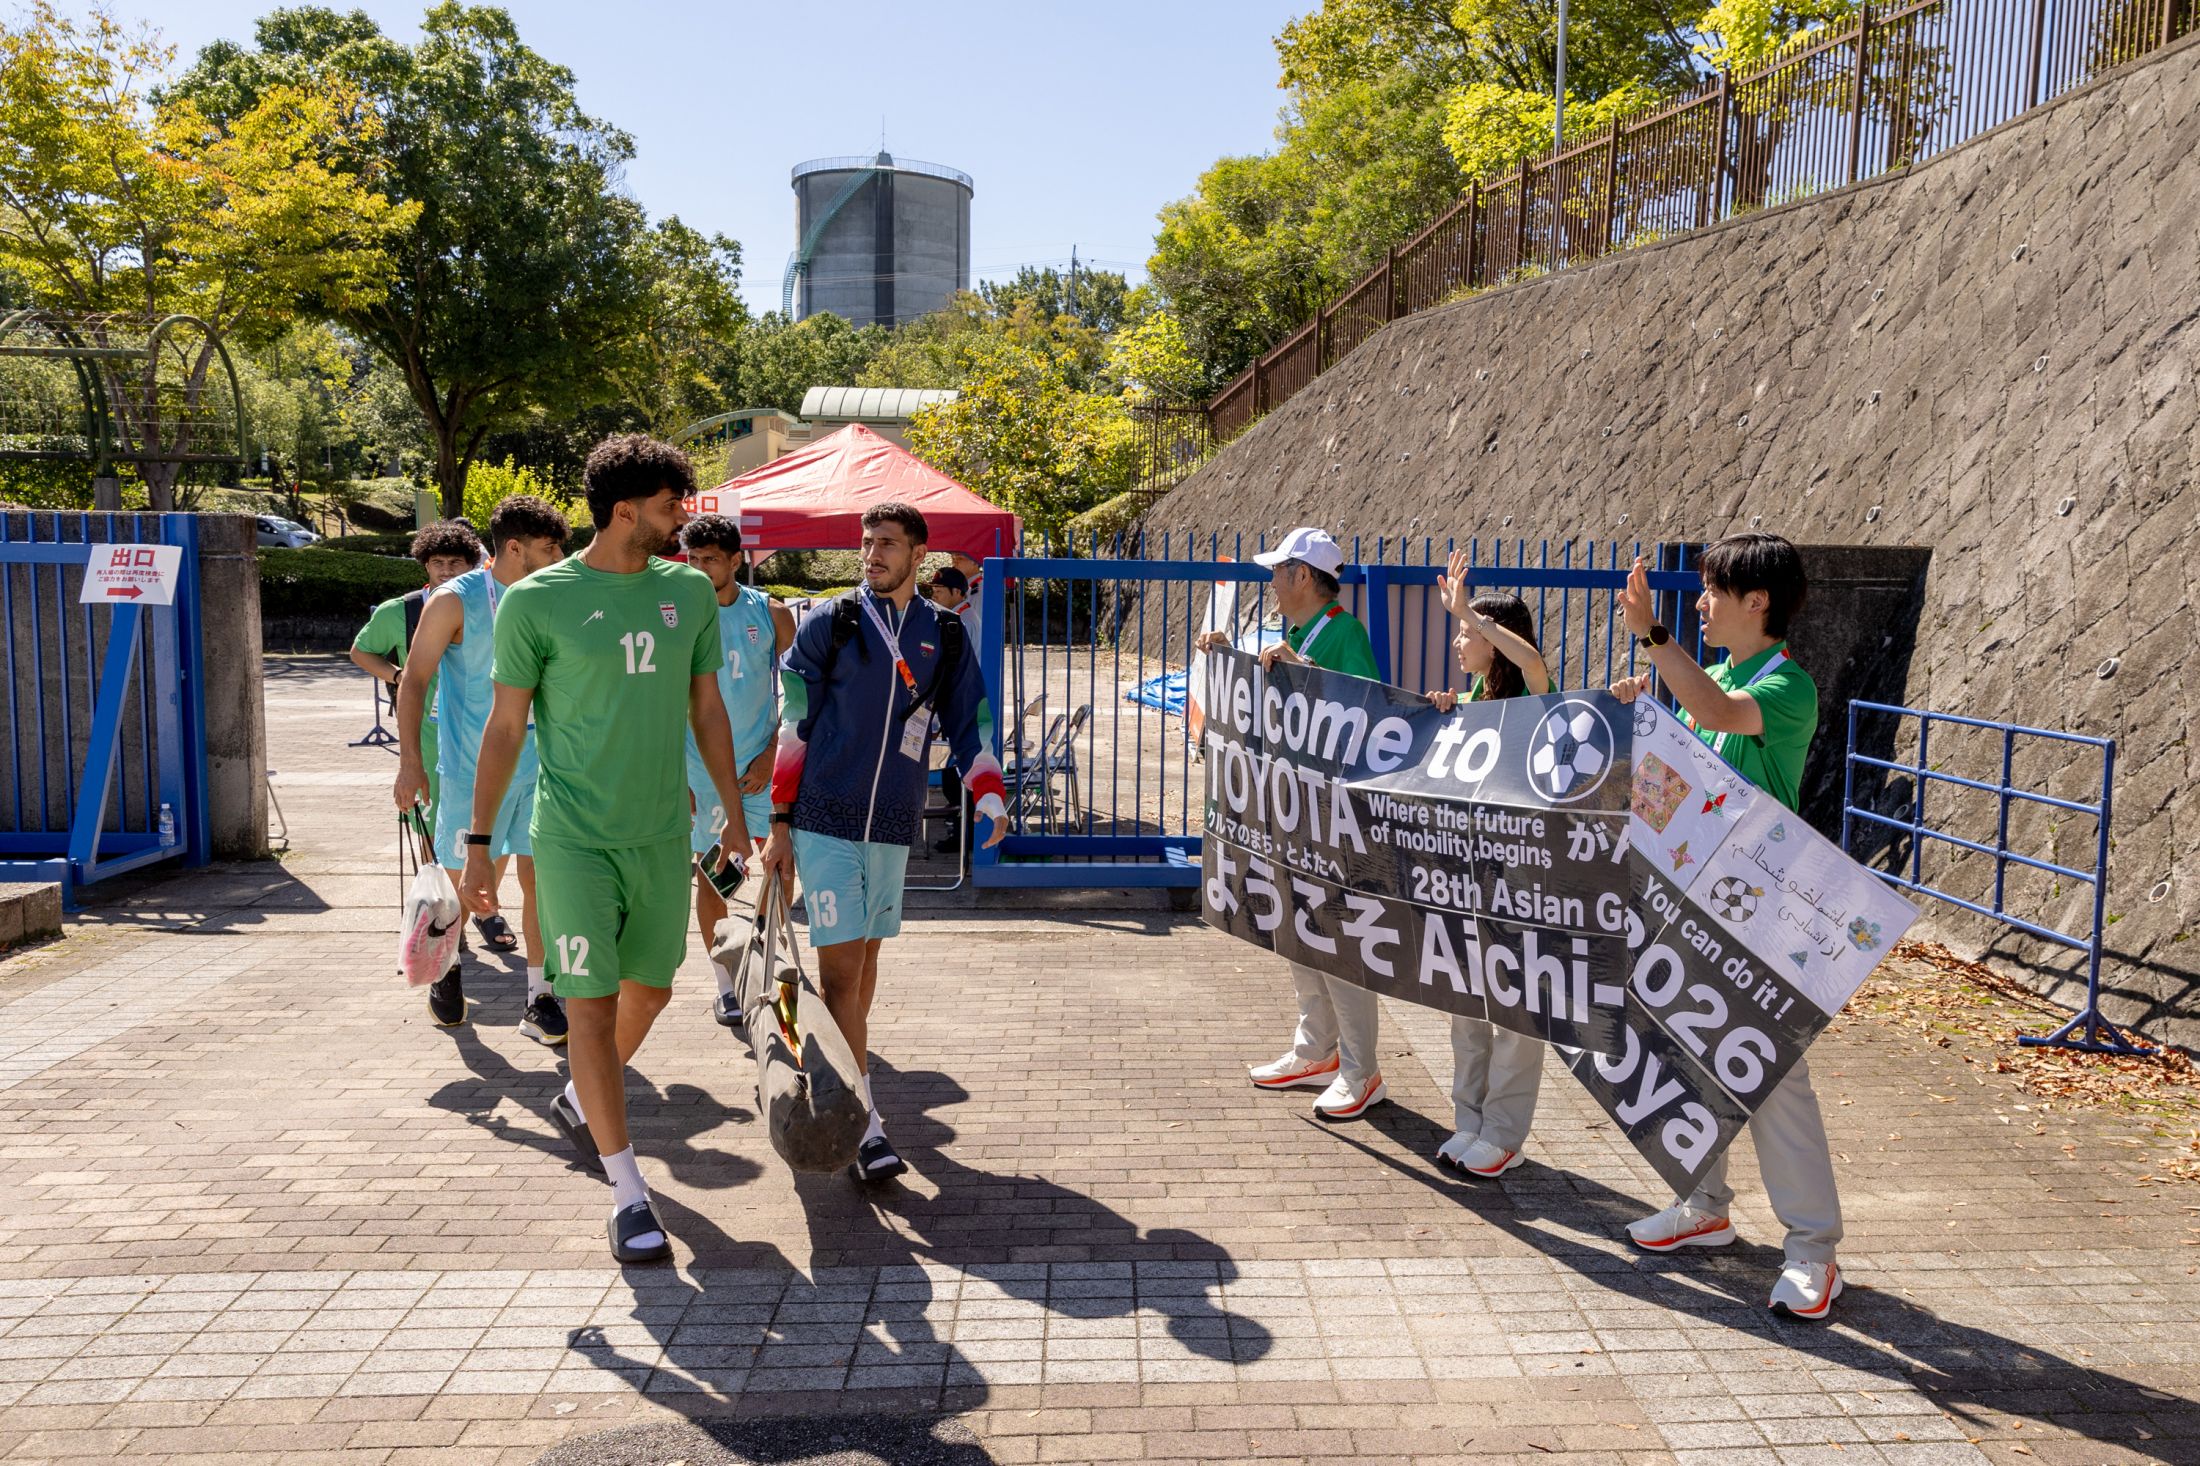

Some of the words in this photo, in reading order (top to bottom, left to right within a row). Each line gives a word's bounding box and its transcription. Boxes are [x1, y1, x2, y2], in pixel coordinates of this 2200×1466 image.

[110, 547, 156, 567] 出口
[620, 631, 656, 674] 12
[728, 650, 743, 679] 2
[1209, 651, 1413, 772] Welcome
[1427, 717, 1500, 782] to
[1207, 729, 1367, 854] TOYOTA
[710, 805, 725, 834] 2
[1368, 793, 1429, 823] Where
[1435, 801, 1468, 828] the
[1474, 806, 1545, 838] future
[1370, 822, 1389, 843] of
[1208, 811, 1345, 880] クルマのまち・とよたへ
[810, 890, 838, 928] 13
[1207, 840, 1400, 978] ようこそ
[1411, 866, 1482, 910] 28th
[1491, 878, 1585, 927] Asian
[1642, 874, 1682, 925] You
[1681, 919, 1722, 964] can
[1722, 958, 1754, 989] do
[555, 934, 590, 976] 12
[1419, 912, 1625, 1024] Aichi-
